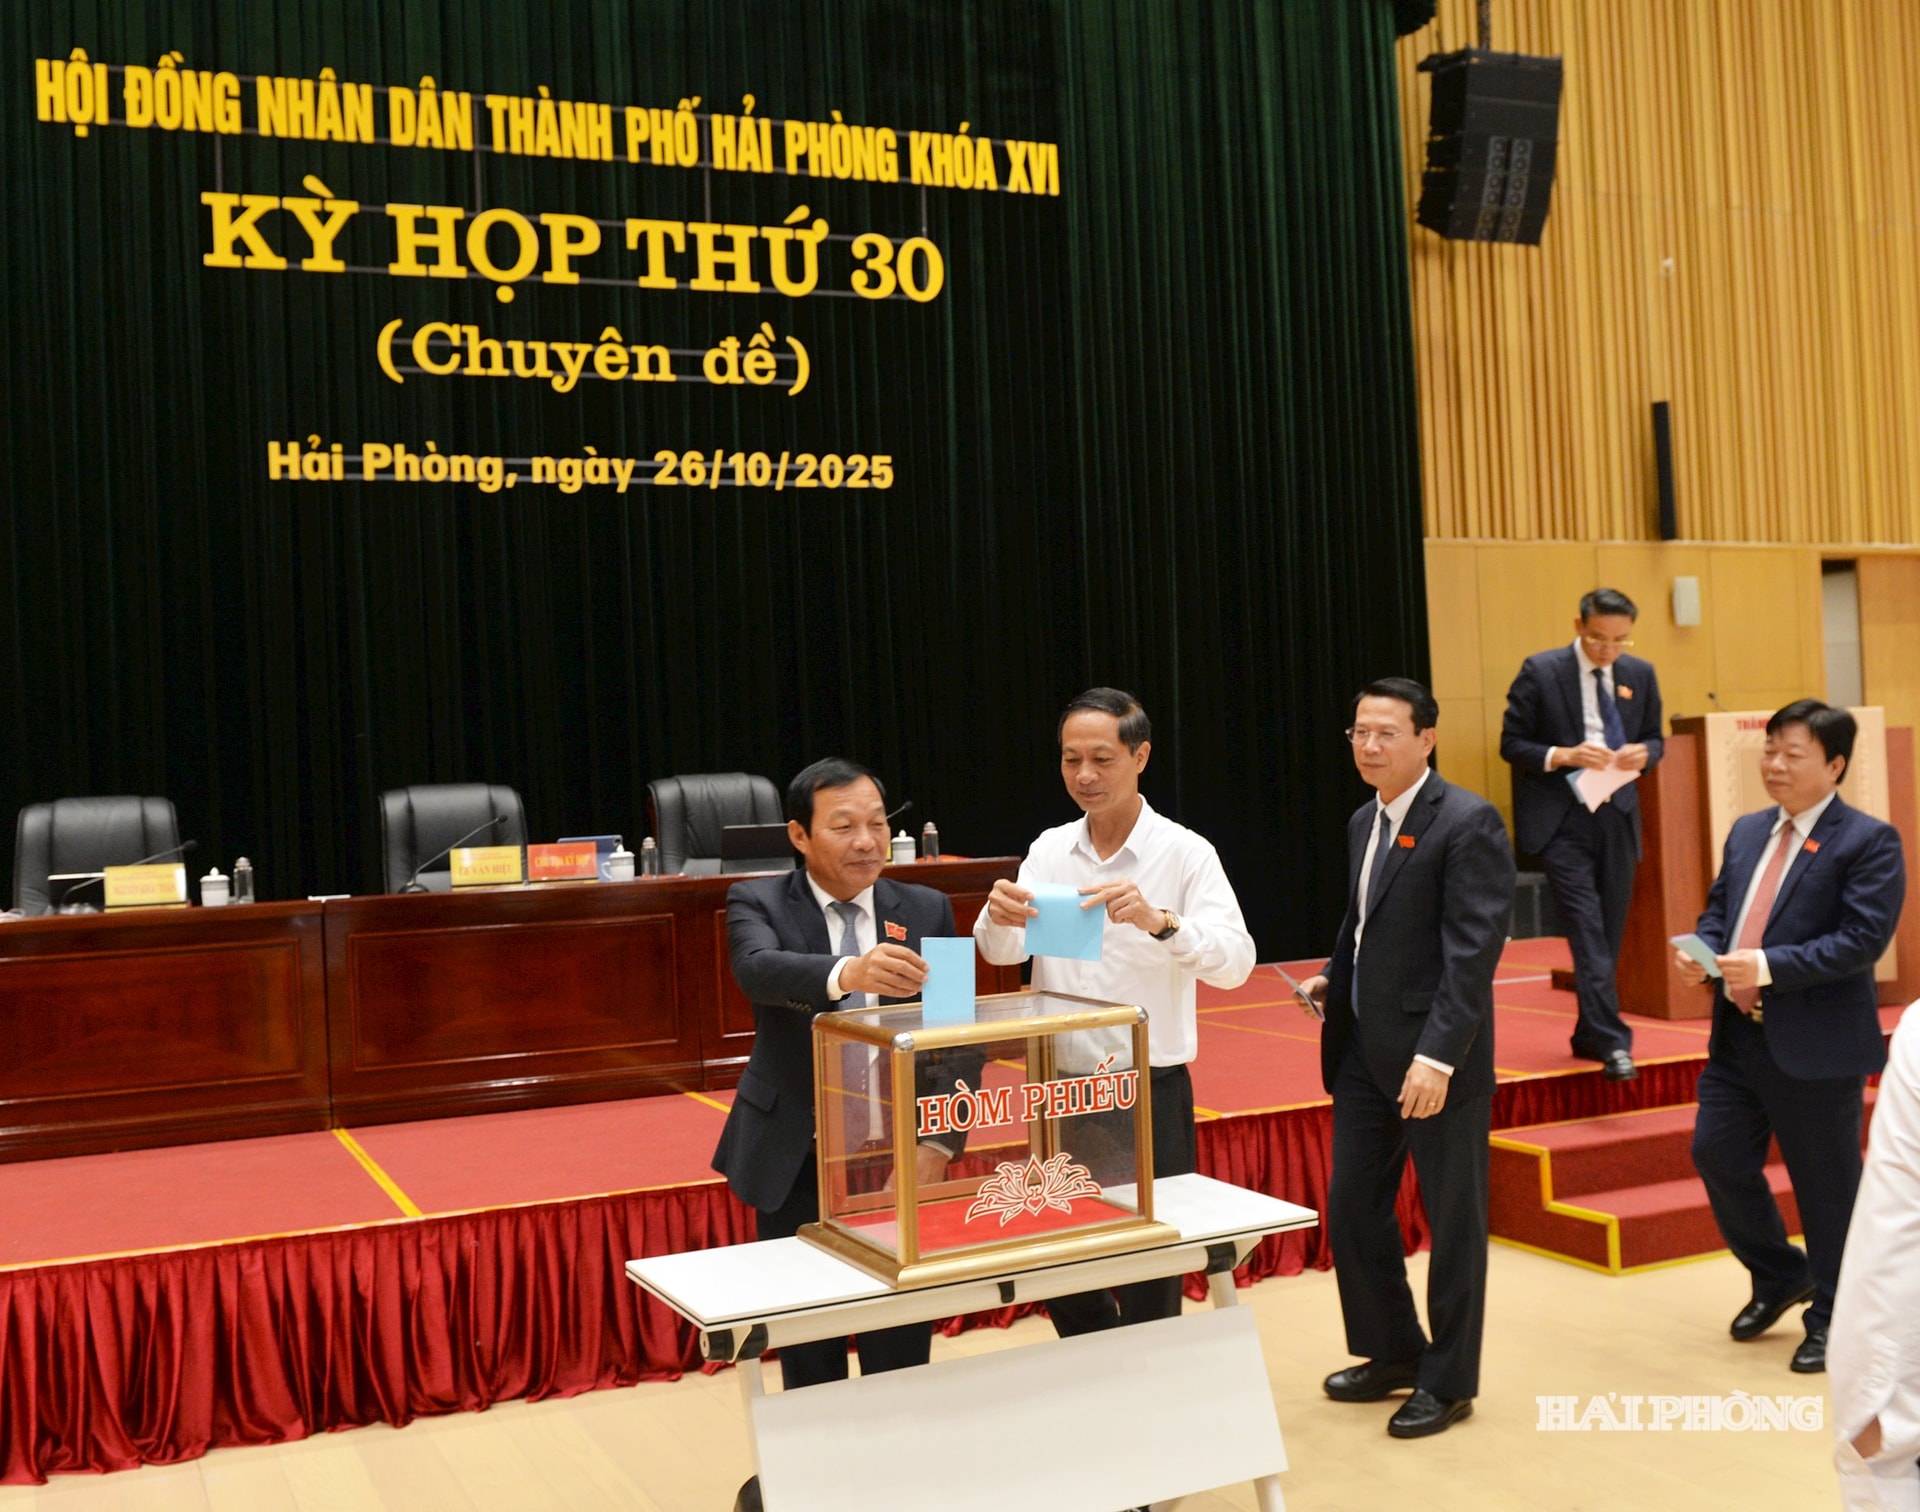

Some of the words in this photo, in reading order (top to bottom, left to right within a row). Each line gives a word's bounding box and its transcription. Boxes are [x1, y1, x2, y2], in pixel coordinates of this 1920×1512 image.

[36, 48, 109, 137] HỘI
[124, 51, 242, 134] ĐỒNG
[256, 68, 375, 143] NHÂN
[389, 76, 473, 150] DÂN
[485, 86, 613, 161] THÀNH
[625, 96, 701, 167] PHỐ
[711, 94, 774, 173] HẢI
[784, 110, 899, 182] PHÒNG
[909, 122, 998, 190] KHÓA
[1005, 140, 1059, 196] XVI
[201, 175, 359, 272] KỲ
[385, 204, 601, 303] HỌP
[626, 205, 829, 297] THỨ
[851, 233, 944, 302] 30
[377, 319, 677, 392] (Chuyên
[703, 322, 809, 396] đề)
[268, 435, 344, 481] Hải
[363, 441, 518, 492] Phòng,
[531, 446, 636, 493] ngày
[654, 449, 893, 490] 26/10/2025
[917, 1078, 1013, 1137] HÒM
[1021, 1055, 1139, 1123] PHIẾU
